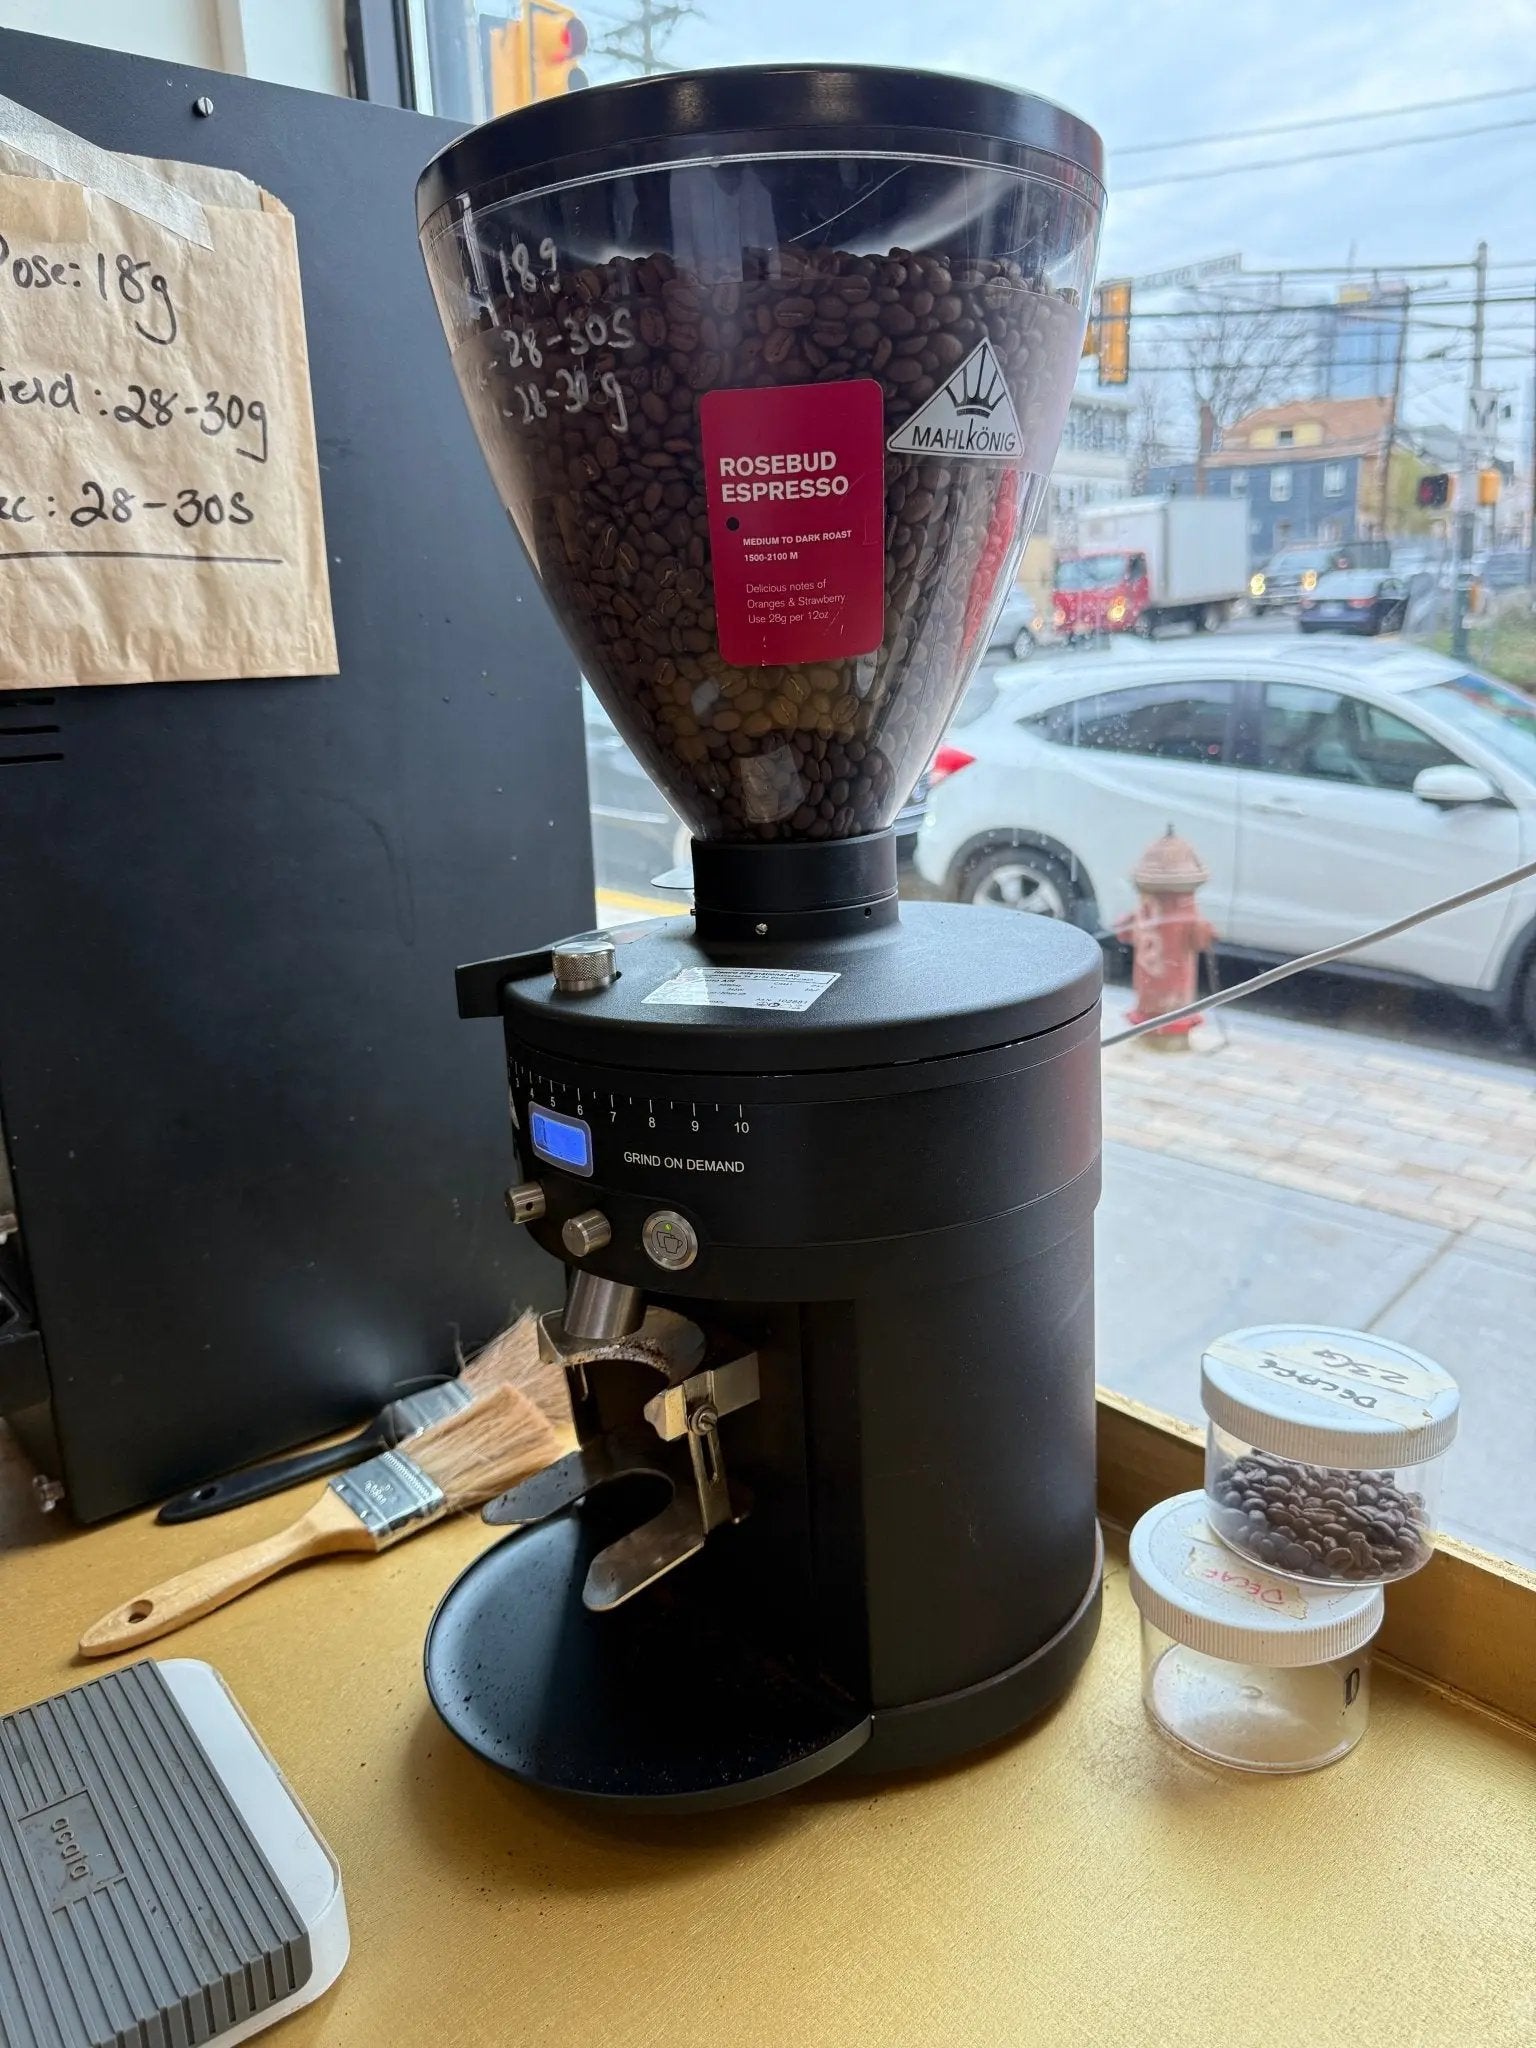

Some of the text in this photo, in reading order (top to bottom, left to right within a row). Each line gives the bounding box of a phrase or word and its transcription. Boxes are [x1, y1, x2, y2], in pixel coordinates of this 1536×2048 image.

[97, 252, 177, 345] 18g
[911, 418, 1016, 452] MAHLKÖNIG
[720, 451, 837, 477] ROSEBUD
[721, 475, 849, 503] ESPRESSO
[743, 530, 852, 546] MEDIUM TO DARK ROAST
[744, 551, 799, 562] 1500-2100 M
[746, 578, 827, 594] Delicious notes of
[747, 593, 846, 611] Oranges & Strawberry
[748, 610, 829, 625] Use 28g per 12oz
[550, 1096, 556, 1108] 5
[577, 1104, 584, 1116] 6
[610, 1111, 617, 1123] 7
[648, 1117, 656, 1128] 8
[691, 1121, 700, 1132] 9
[734, 1122, 750, 1134] 10
[623, 1151, 745, 1174] GRIND ON DEMAND
